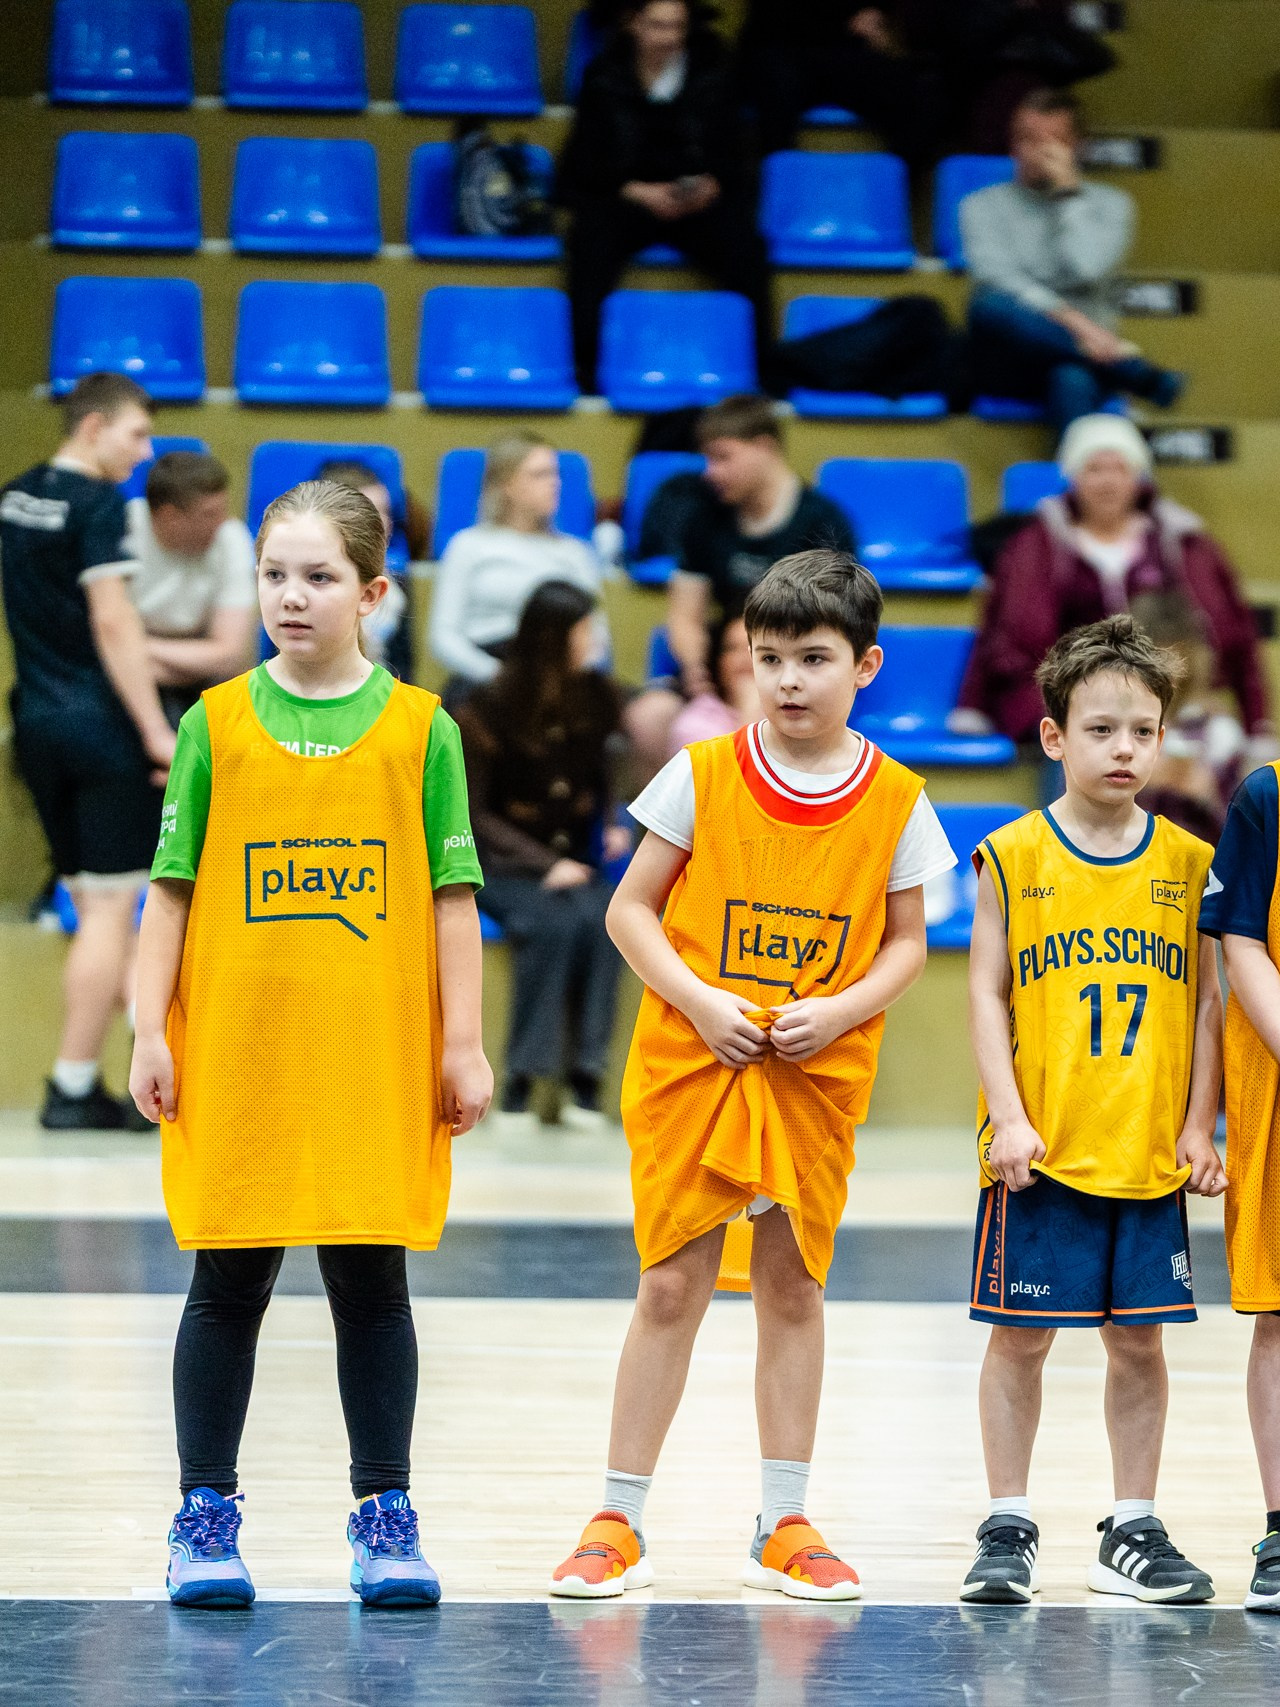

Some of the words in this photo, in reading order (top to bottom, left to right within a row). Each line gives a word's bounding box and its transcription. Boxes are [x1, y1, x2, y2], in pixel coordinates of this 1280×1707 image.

[280, 837, 357, 849] SCHOOL
[262, 859, 377, 903] plays.
[751, 902, 826, 920] SCHOOL
[1079, 983, 1149, 1057] 17
[1010, 1280, 1051, 1297] plays.
